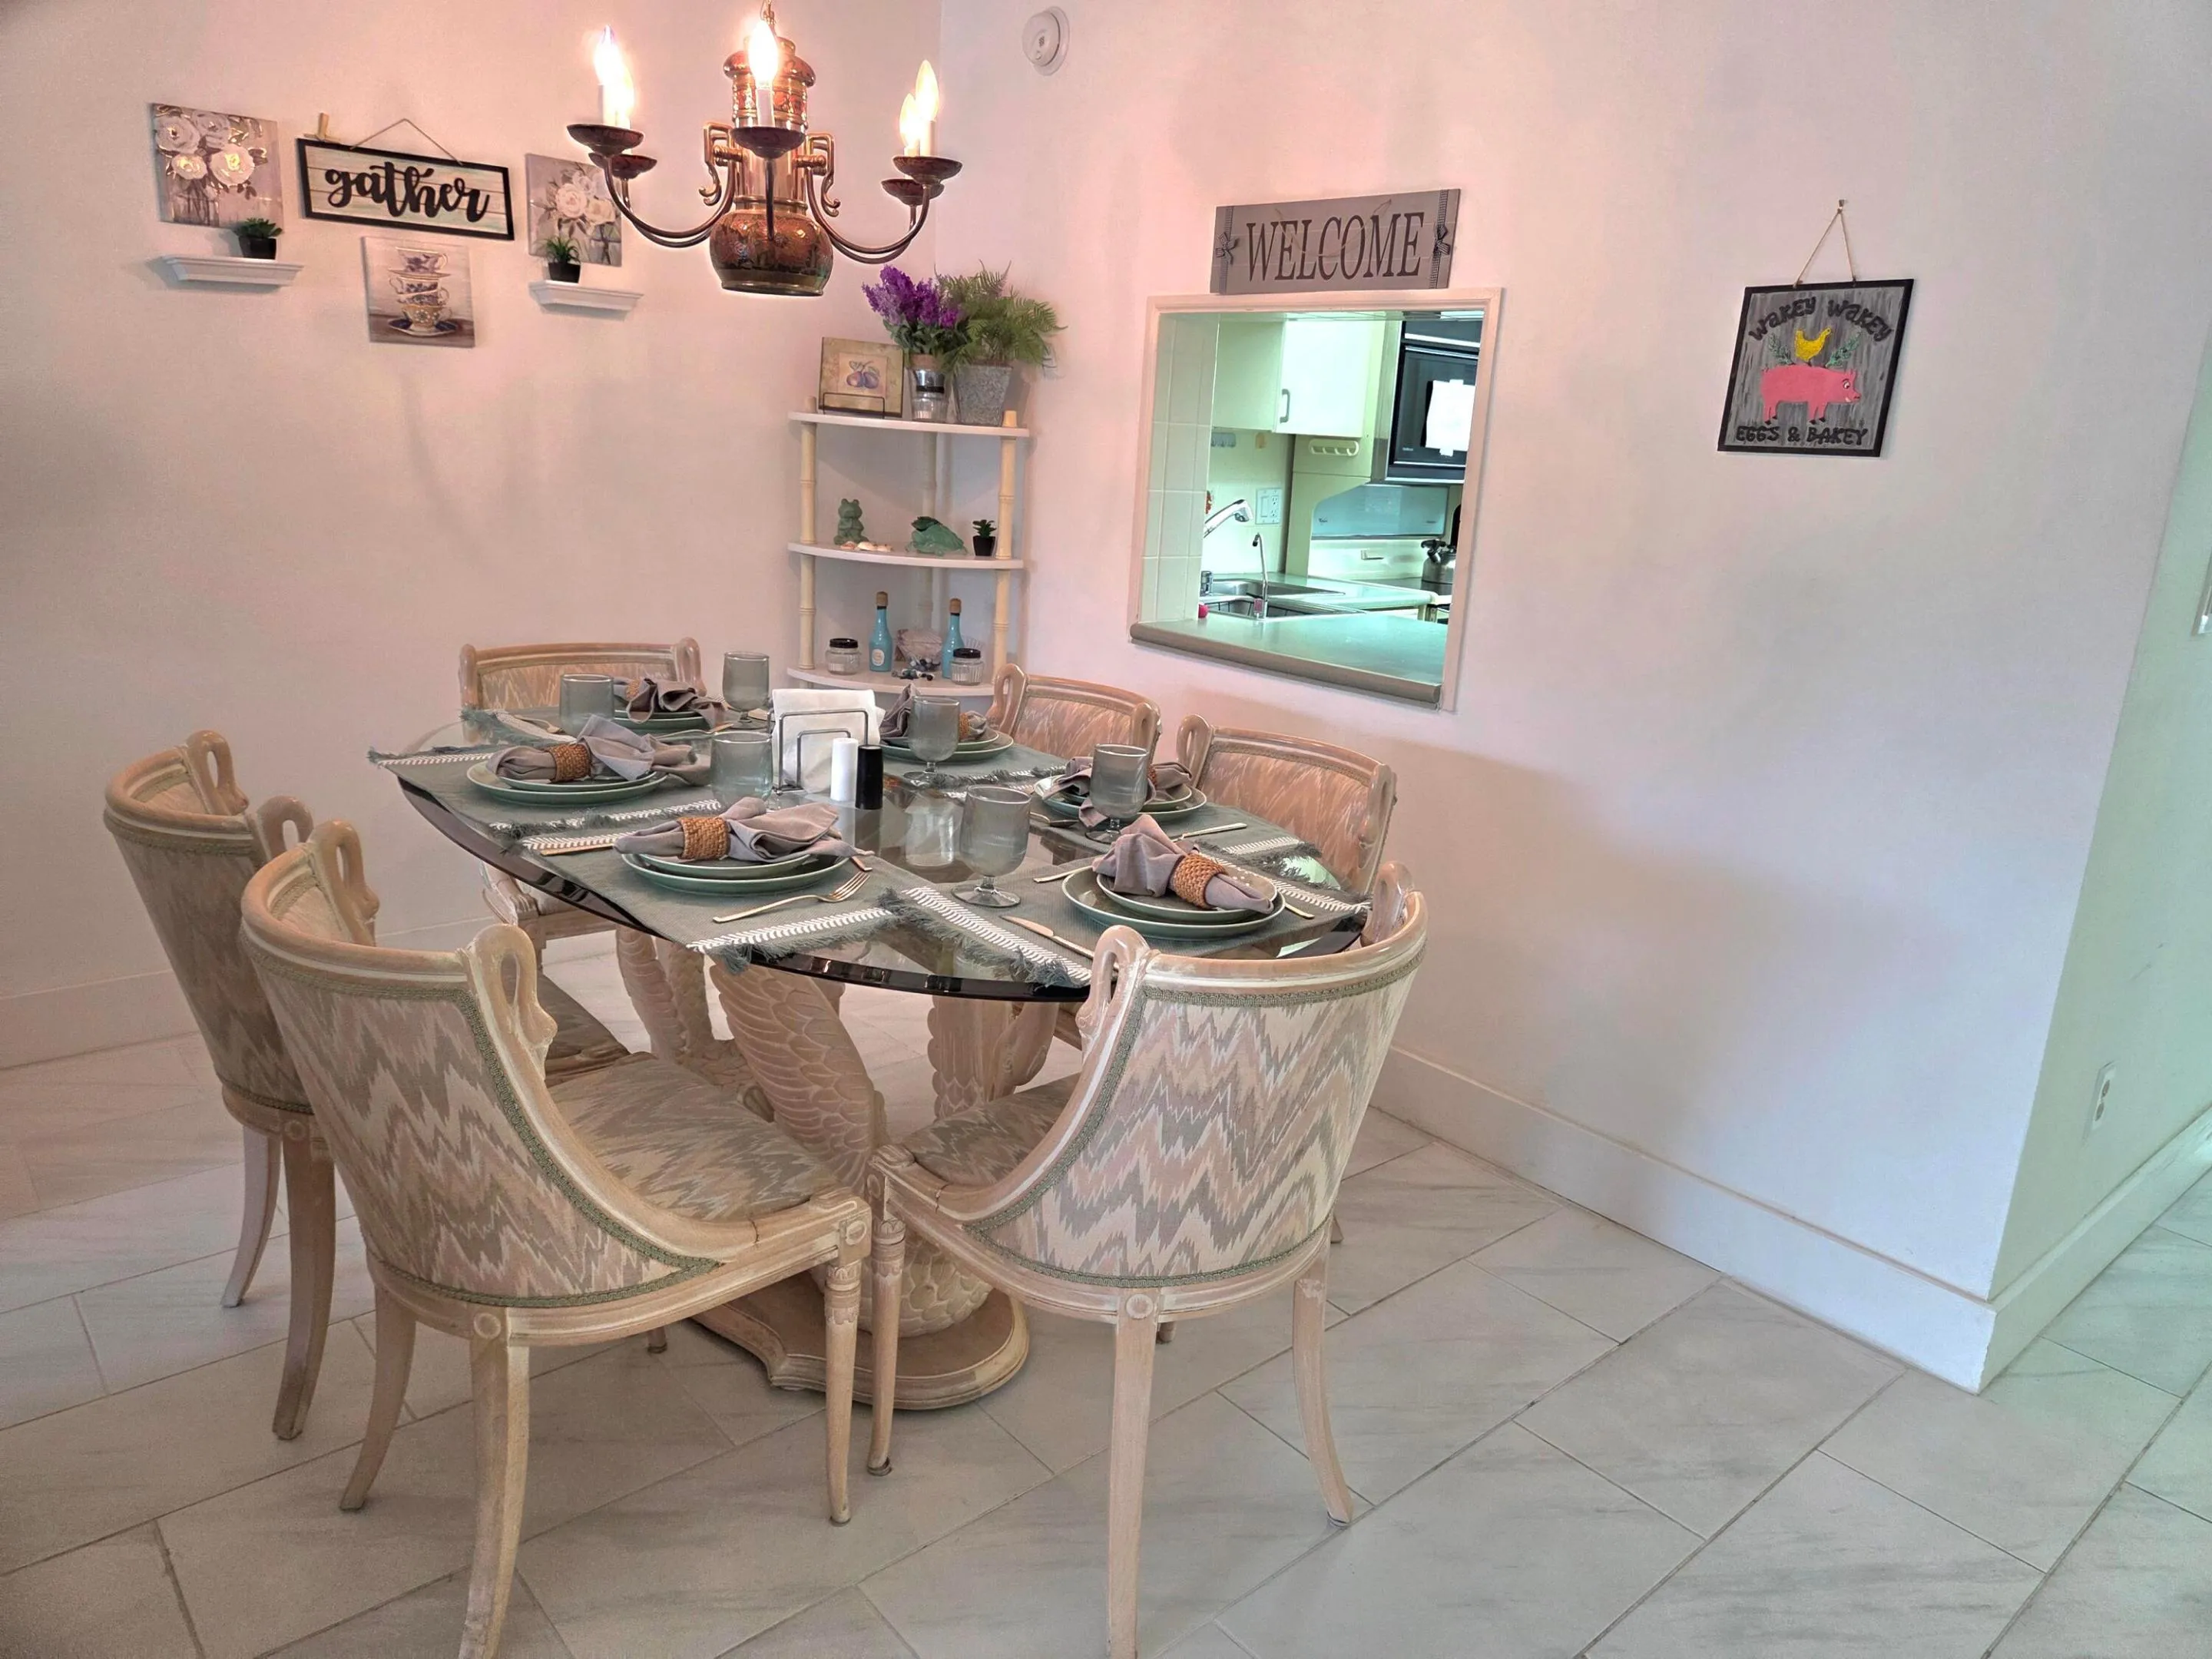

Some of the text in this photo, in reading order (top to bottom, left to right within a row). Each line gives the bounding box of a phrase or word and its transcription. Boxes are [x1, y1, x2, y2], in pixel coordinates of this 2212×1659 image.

[324, 161, 490, 223] gather
[1246, 211, 1425, 283] WELCOME
[1736, 426, 1869, 445] EGGS & BAKEY
